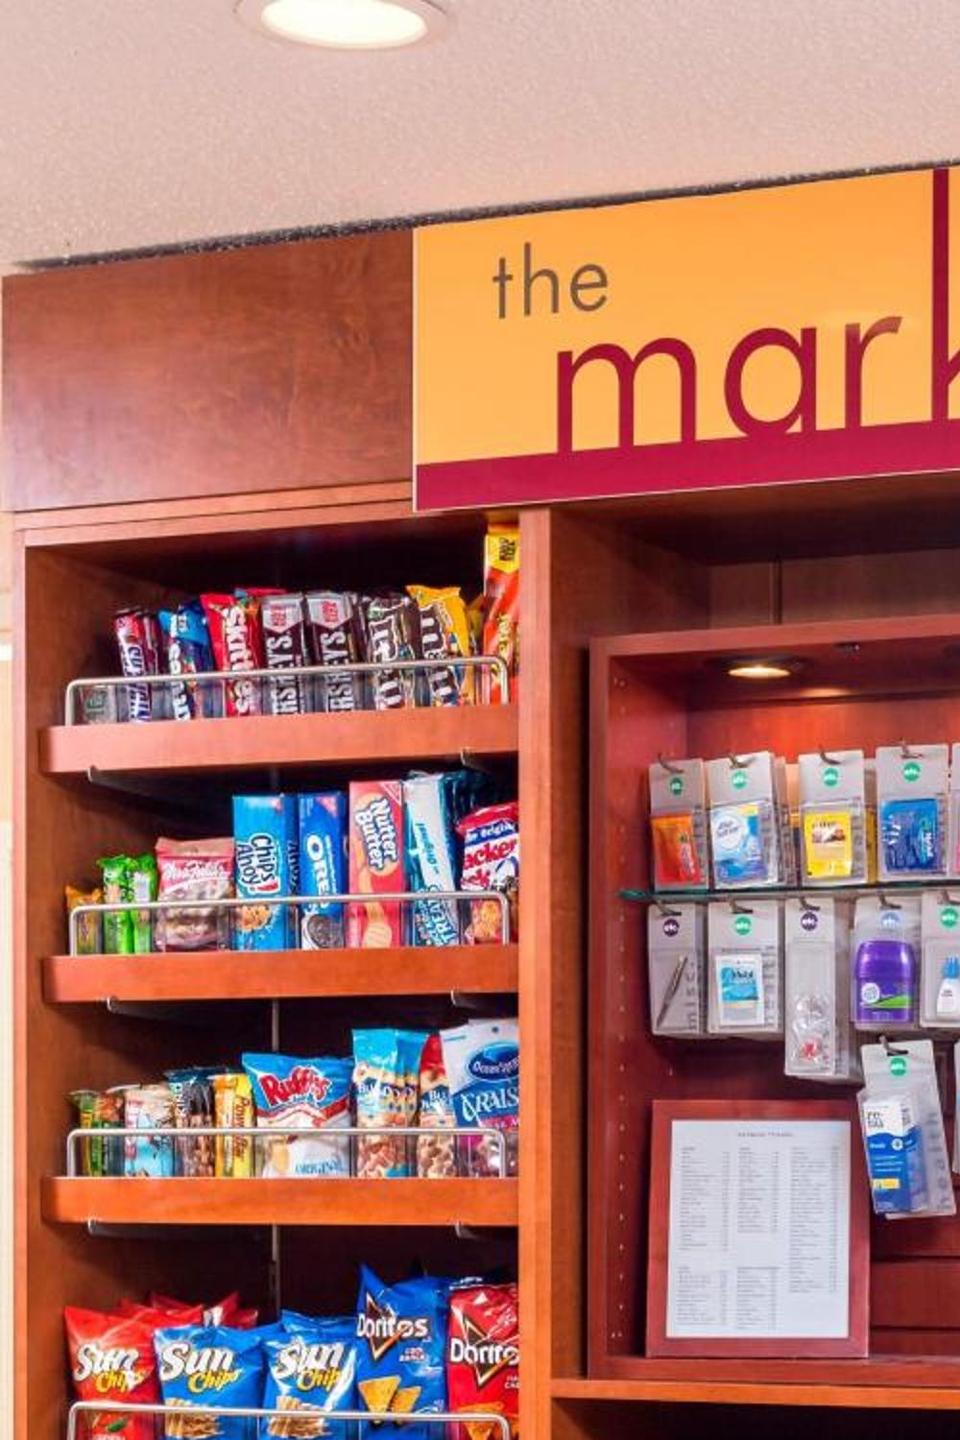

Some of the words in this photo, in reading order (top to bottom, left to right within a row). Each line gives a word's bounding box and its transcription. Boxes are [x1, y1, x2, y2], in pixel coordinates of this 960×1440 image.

[492, 242, 609, 319] the
[223, 606, 255, 714] Skittes
[267, 635, 299, 715] RSHY'S
[319, 630, 354, 711] RSHY'S
[354, 809, 384, 871] Butter
[370, 797, 398, 862] Nutter
[249, 833, 278, 882] Chips
[464, 839, 518, 870] acker
[259, 1065, 332, 1107] Ruffles
[461, 1086, 519, 1122] CRAIS
[234, 1096, 251, 1159] PowBar
[356, 1313, 429, 1339] Doritos
[73, 1341, 139, 1382] Sun
[159, 1341, 235, 1382] Sun
[273, 1338, 346, 1377] Sun
[450, 1338, 520, 1366] Dorito
[95, 1367, 148, 1393] Chips
[187, 1367, 242, 1393] Chips
[296, 1365, 342, 1392] Chip
